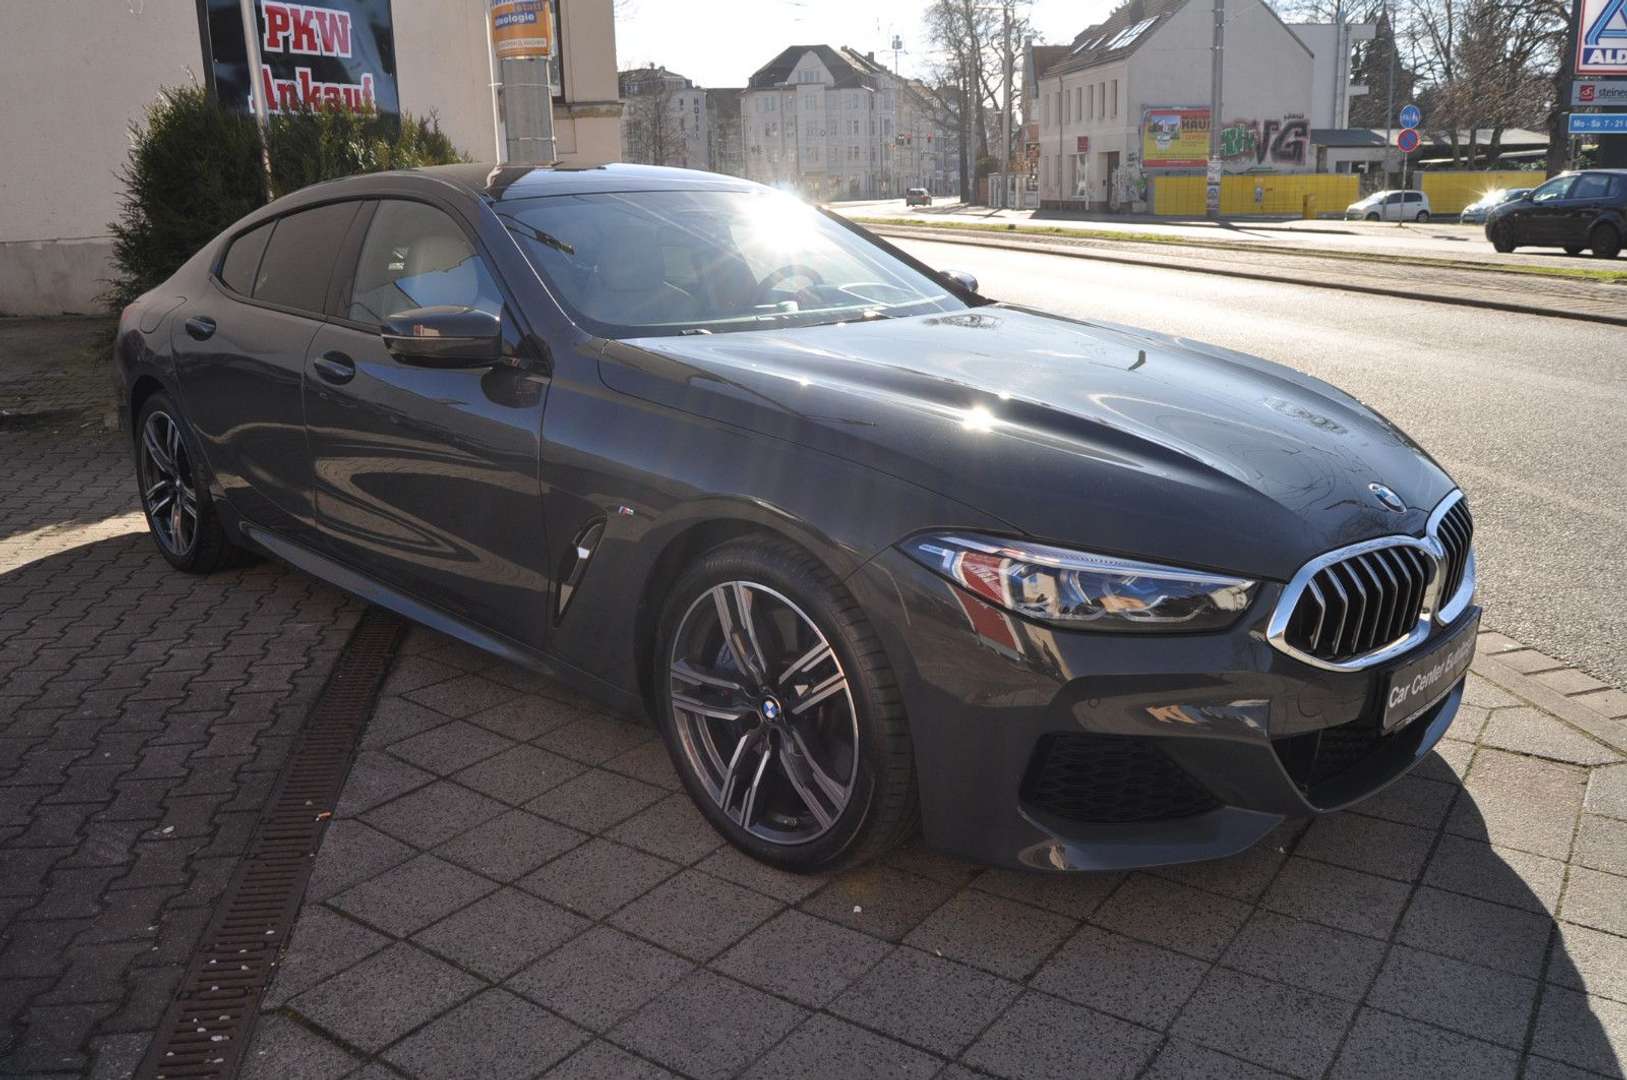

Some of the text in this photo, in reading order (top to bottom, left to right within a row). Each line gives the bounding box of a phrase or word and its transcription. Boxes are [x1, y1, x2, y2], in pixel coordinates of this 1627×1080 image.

[260, 1, 353, 58] PKW
[1573, 119, 1585, 128] Mo
[1389, 661, 1446, 708] Car Center
